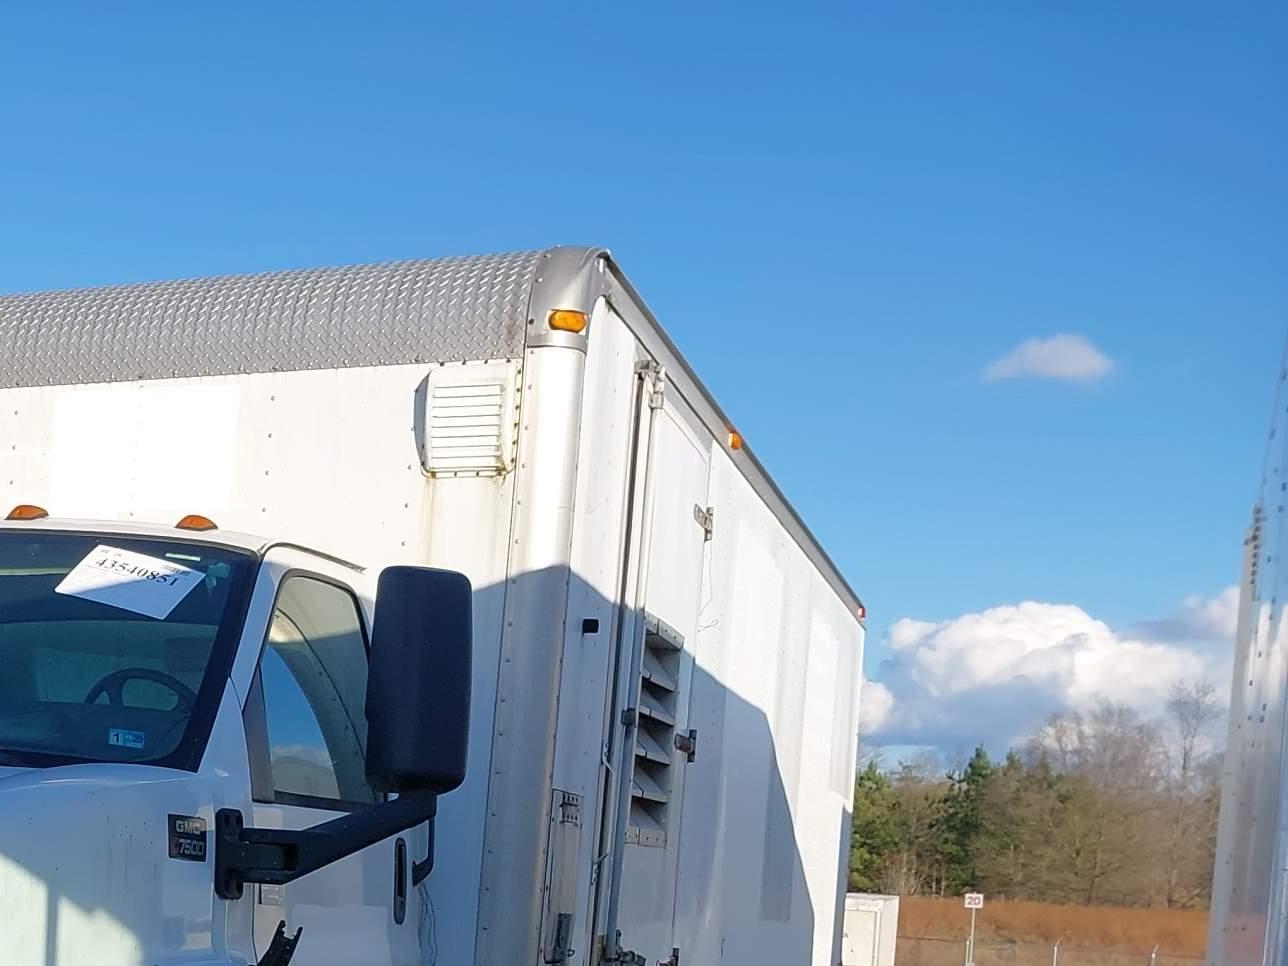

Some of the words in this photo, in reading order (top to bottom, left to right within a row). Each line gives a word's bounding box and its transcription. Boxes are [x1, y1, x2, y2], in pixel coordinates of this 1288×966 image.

[95, 558, 179, 586] 43540851
[175, 819, 201, 835] GMC
[967, 896, 982, 906] 20
